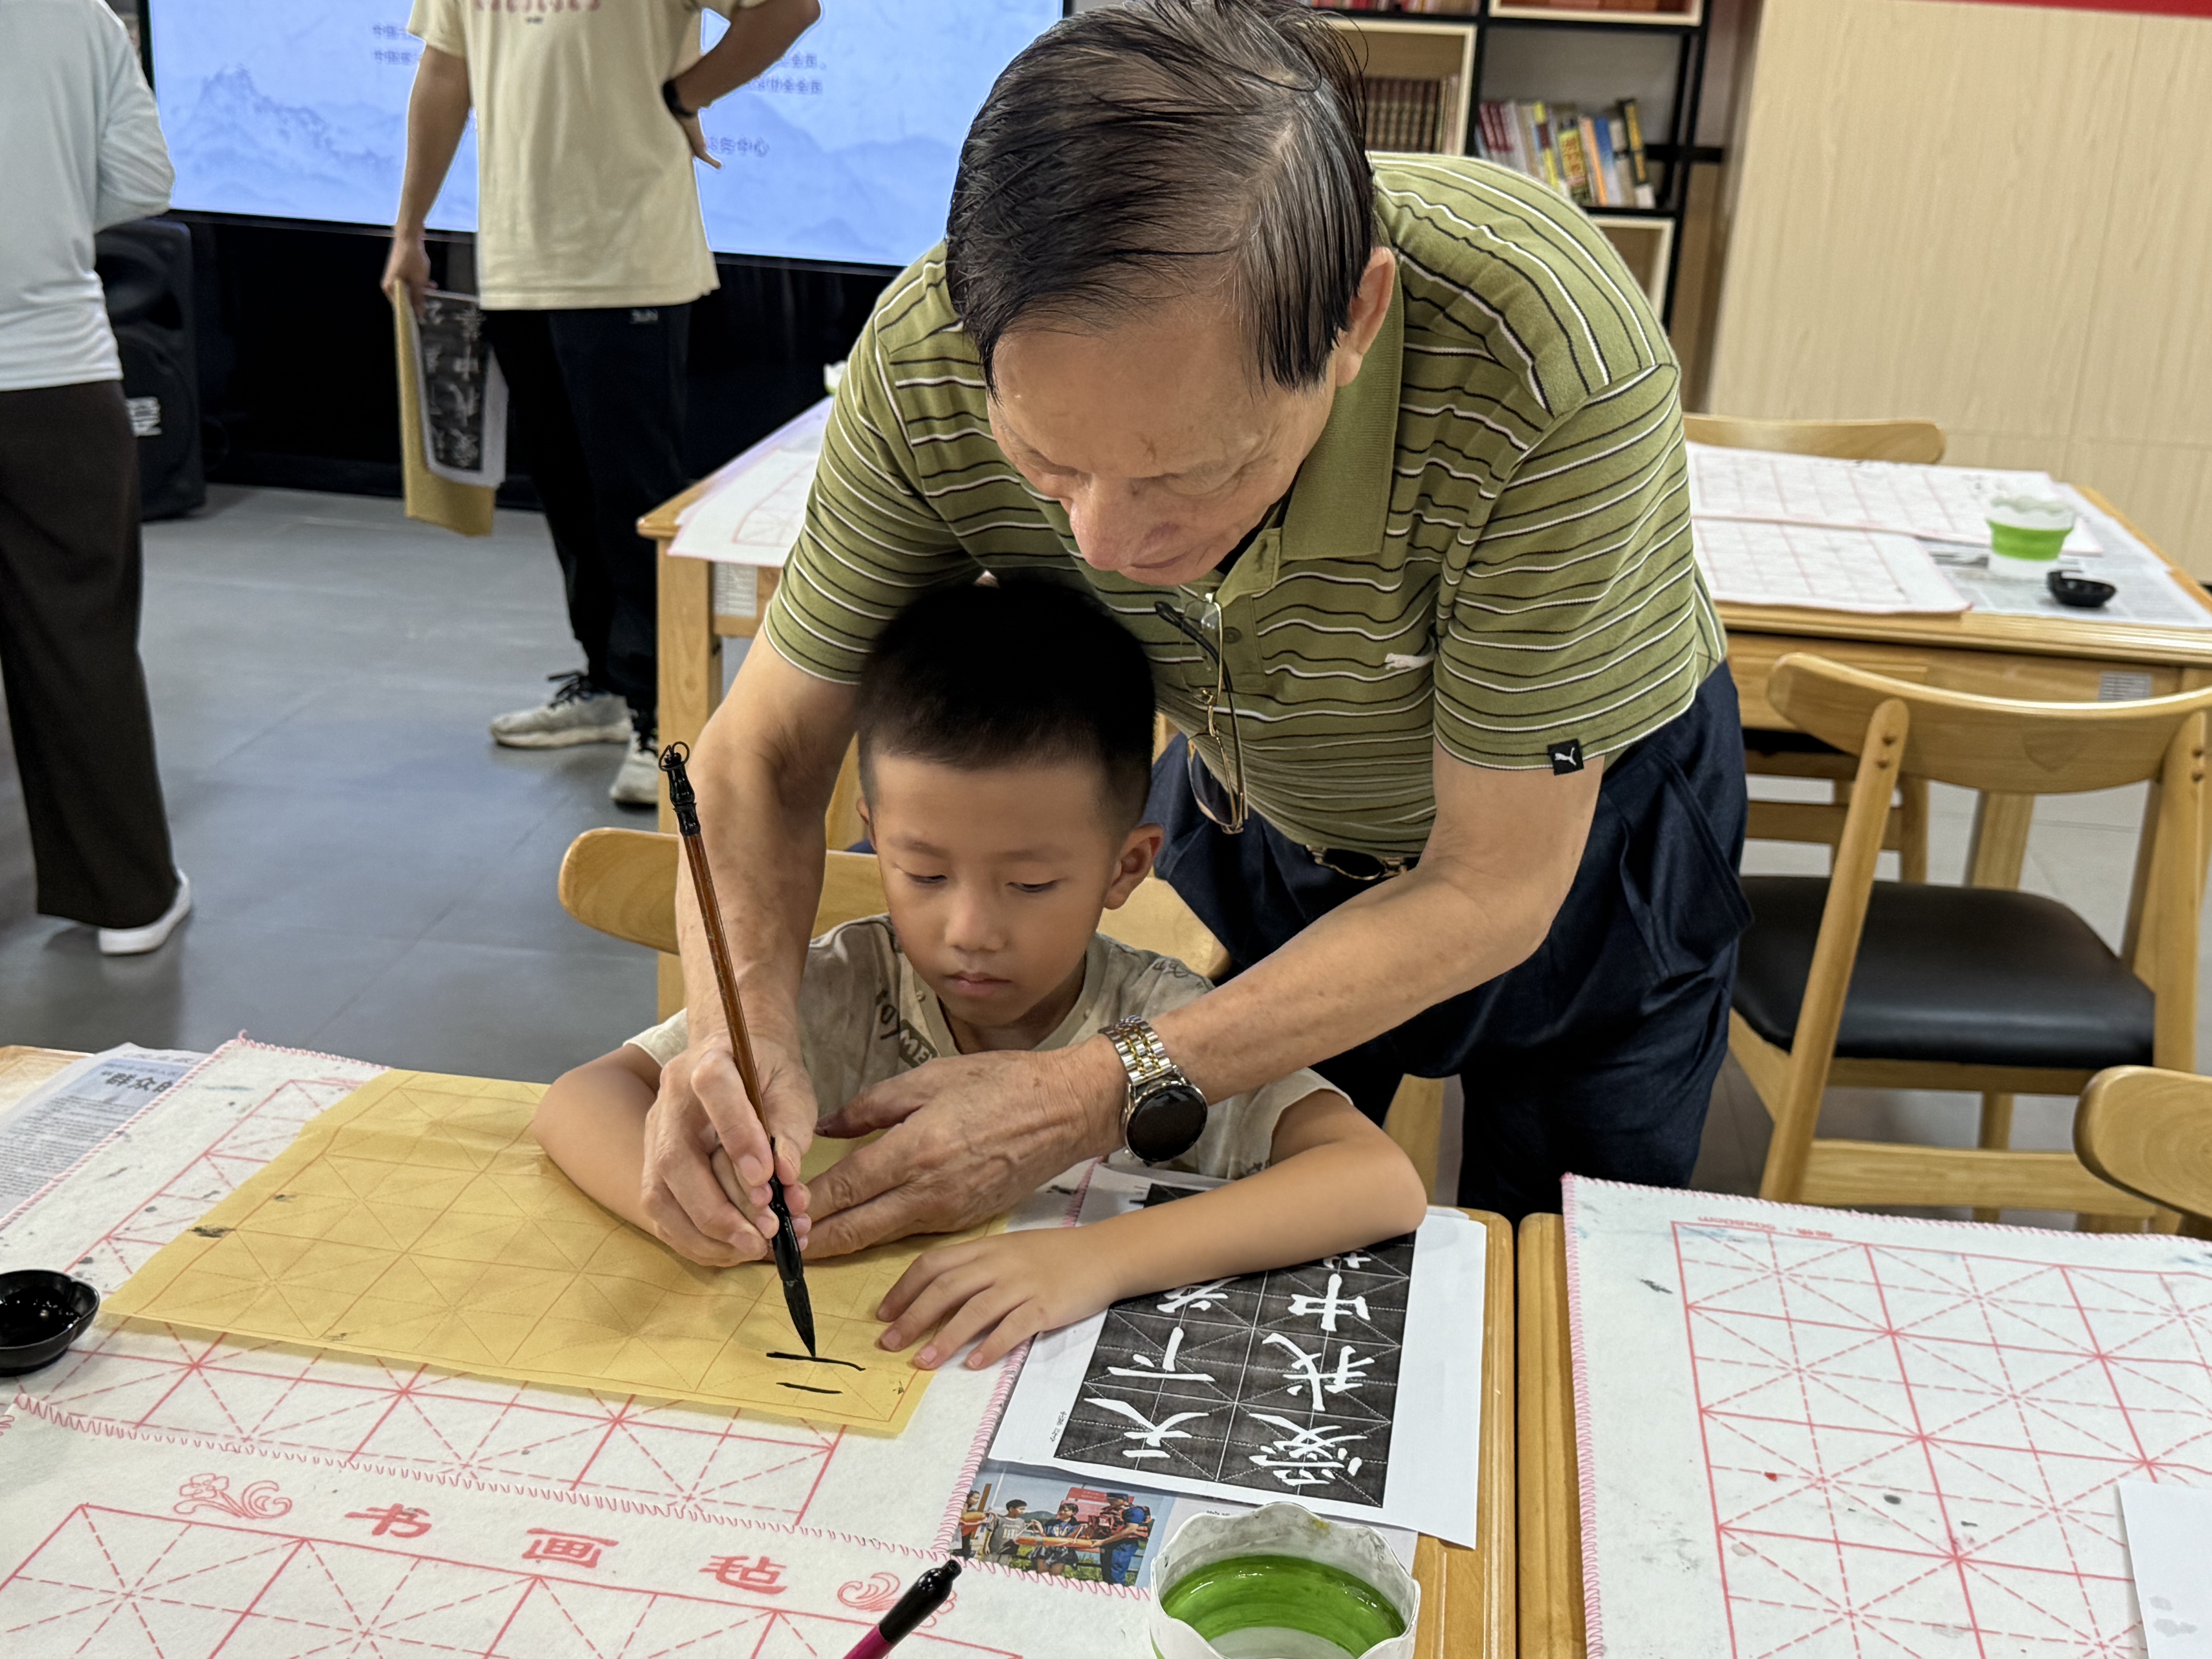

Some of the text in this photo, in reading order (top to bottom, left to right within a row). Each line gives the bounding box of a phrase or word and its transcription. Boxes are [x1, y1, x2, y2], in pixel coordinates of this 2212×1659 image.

[900, 1029, 933, 1064] ME
[1249, 1248, 1375, 1486] 愛我中
[344, 1503, 788, 1595] 书画毡
